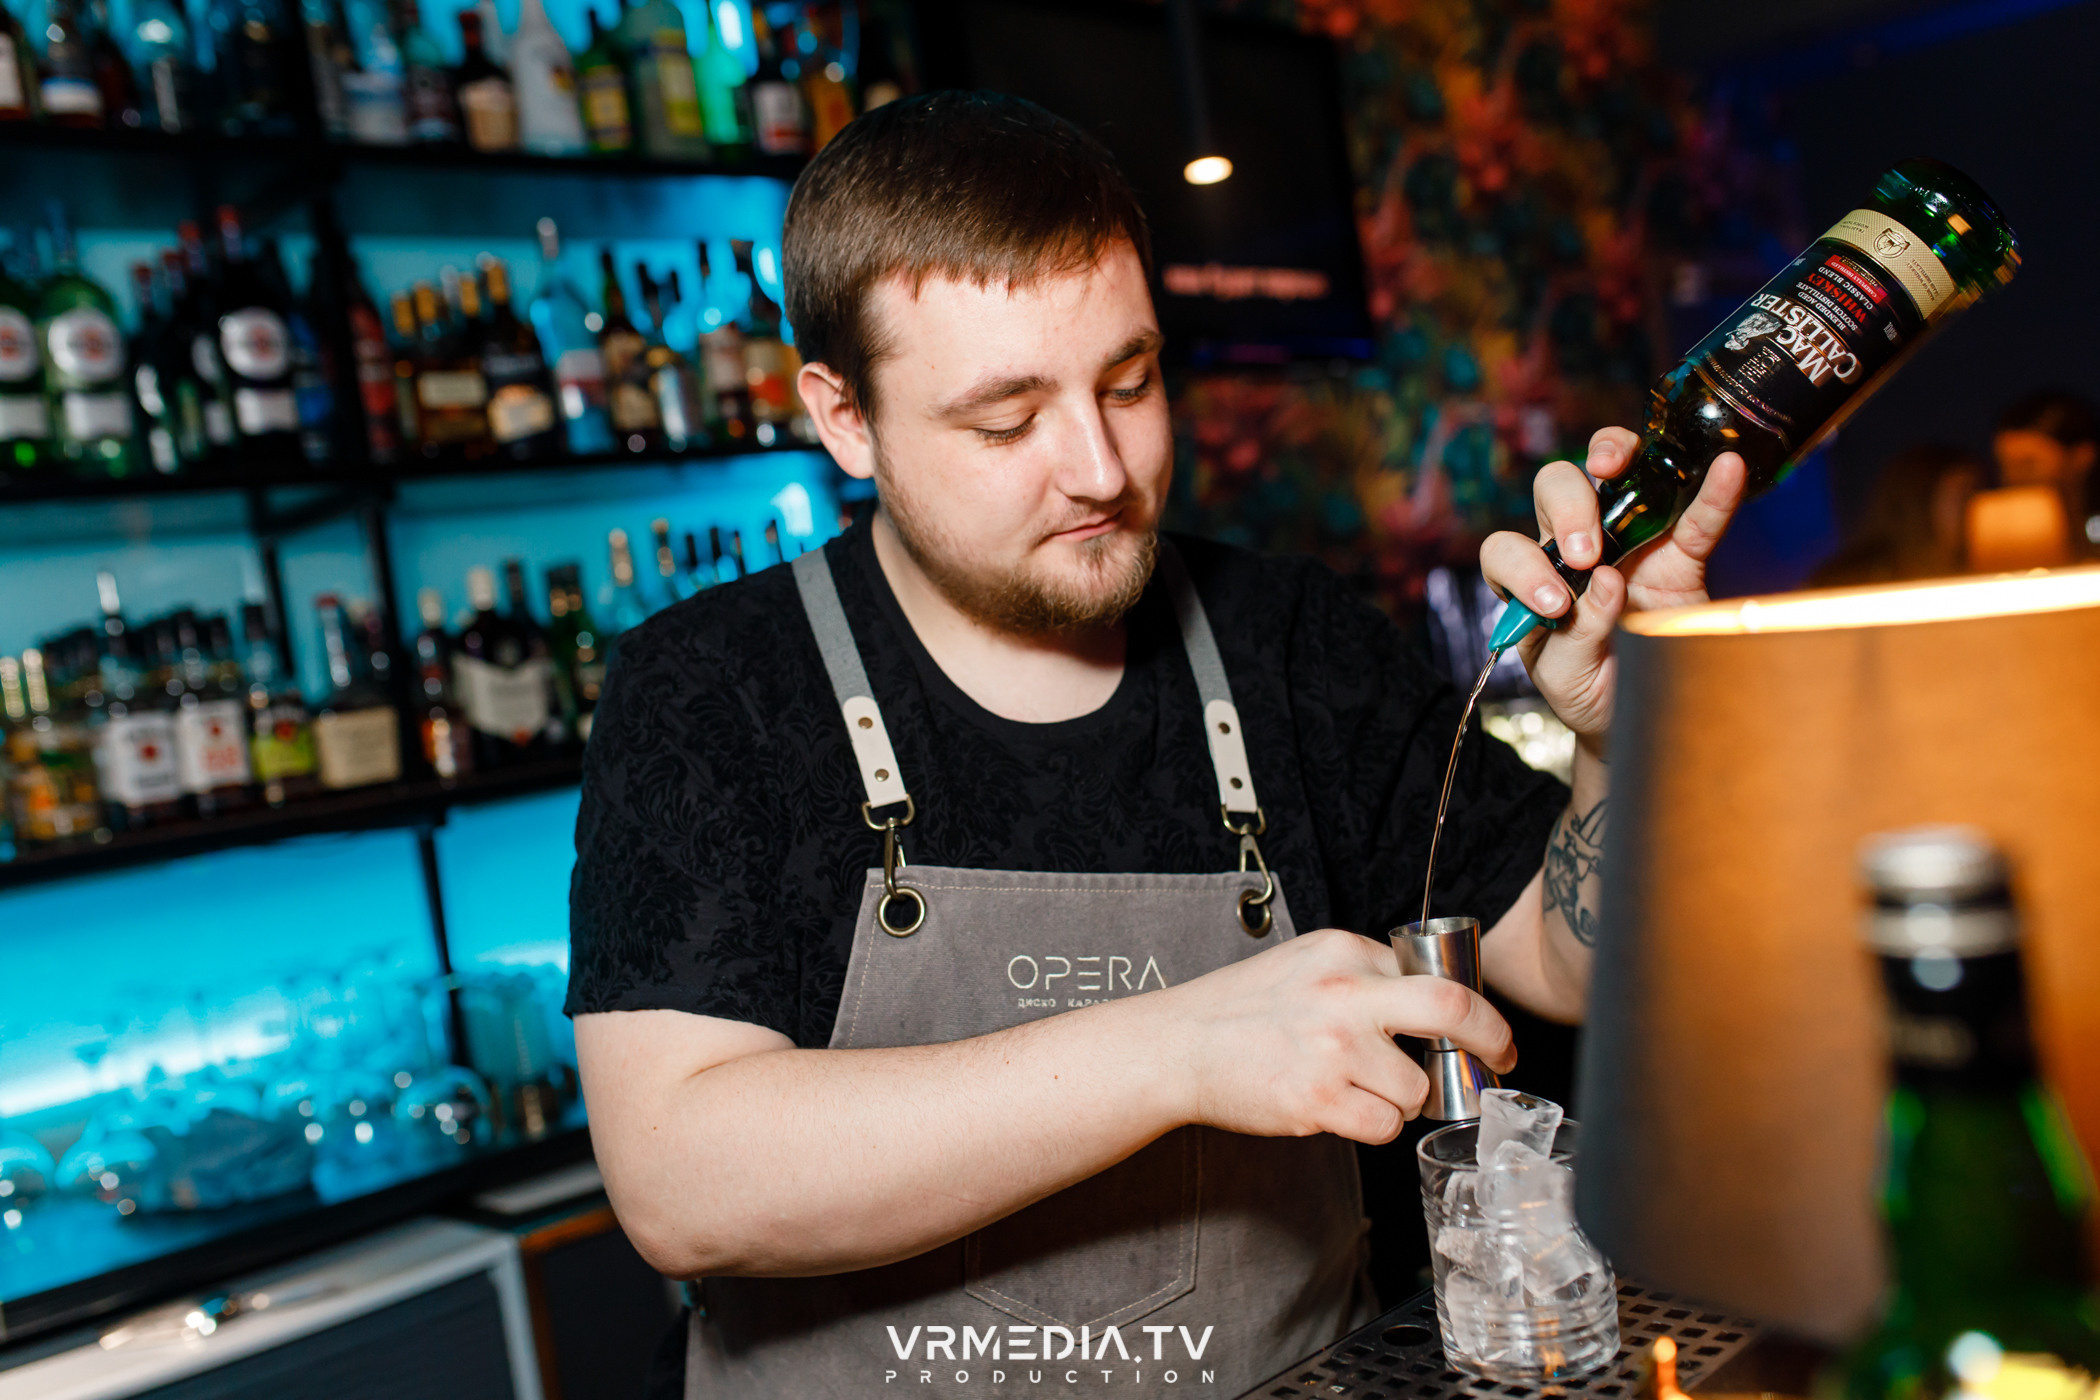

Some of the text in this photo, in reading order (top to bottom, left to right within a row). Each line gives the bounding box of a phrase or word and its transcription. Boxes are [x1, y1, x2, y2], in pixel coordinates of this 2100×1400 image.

[1818, 266, 1844, 283] BLEND
[1852, 275, 1877, 297] CAREFULLY
[1795, 281, 1857, 331] SCOTCH DISTILLATE
[1797, 290, 1846, 330] BLENDED AGED
[1806, 272, 1866, 323] WHISKEY
[1842, 281, 1873, 309] CLASSIC
[1750, 292, 1856, 378] CALLISTER
[1774, 324, 1831, 383] MAC
[1008, 955, 1166, 990] OPERA
